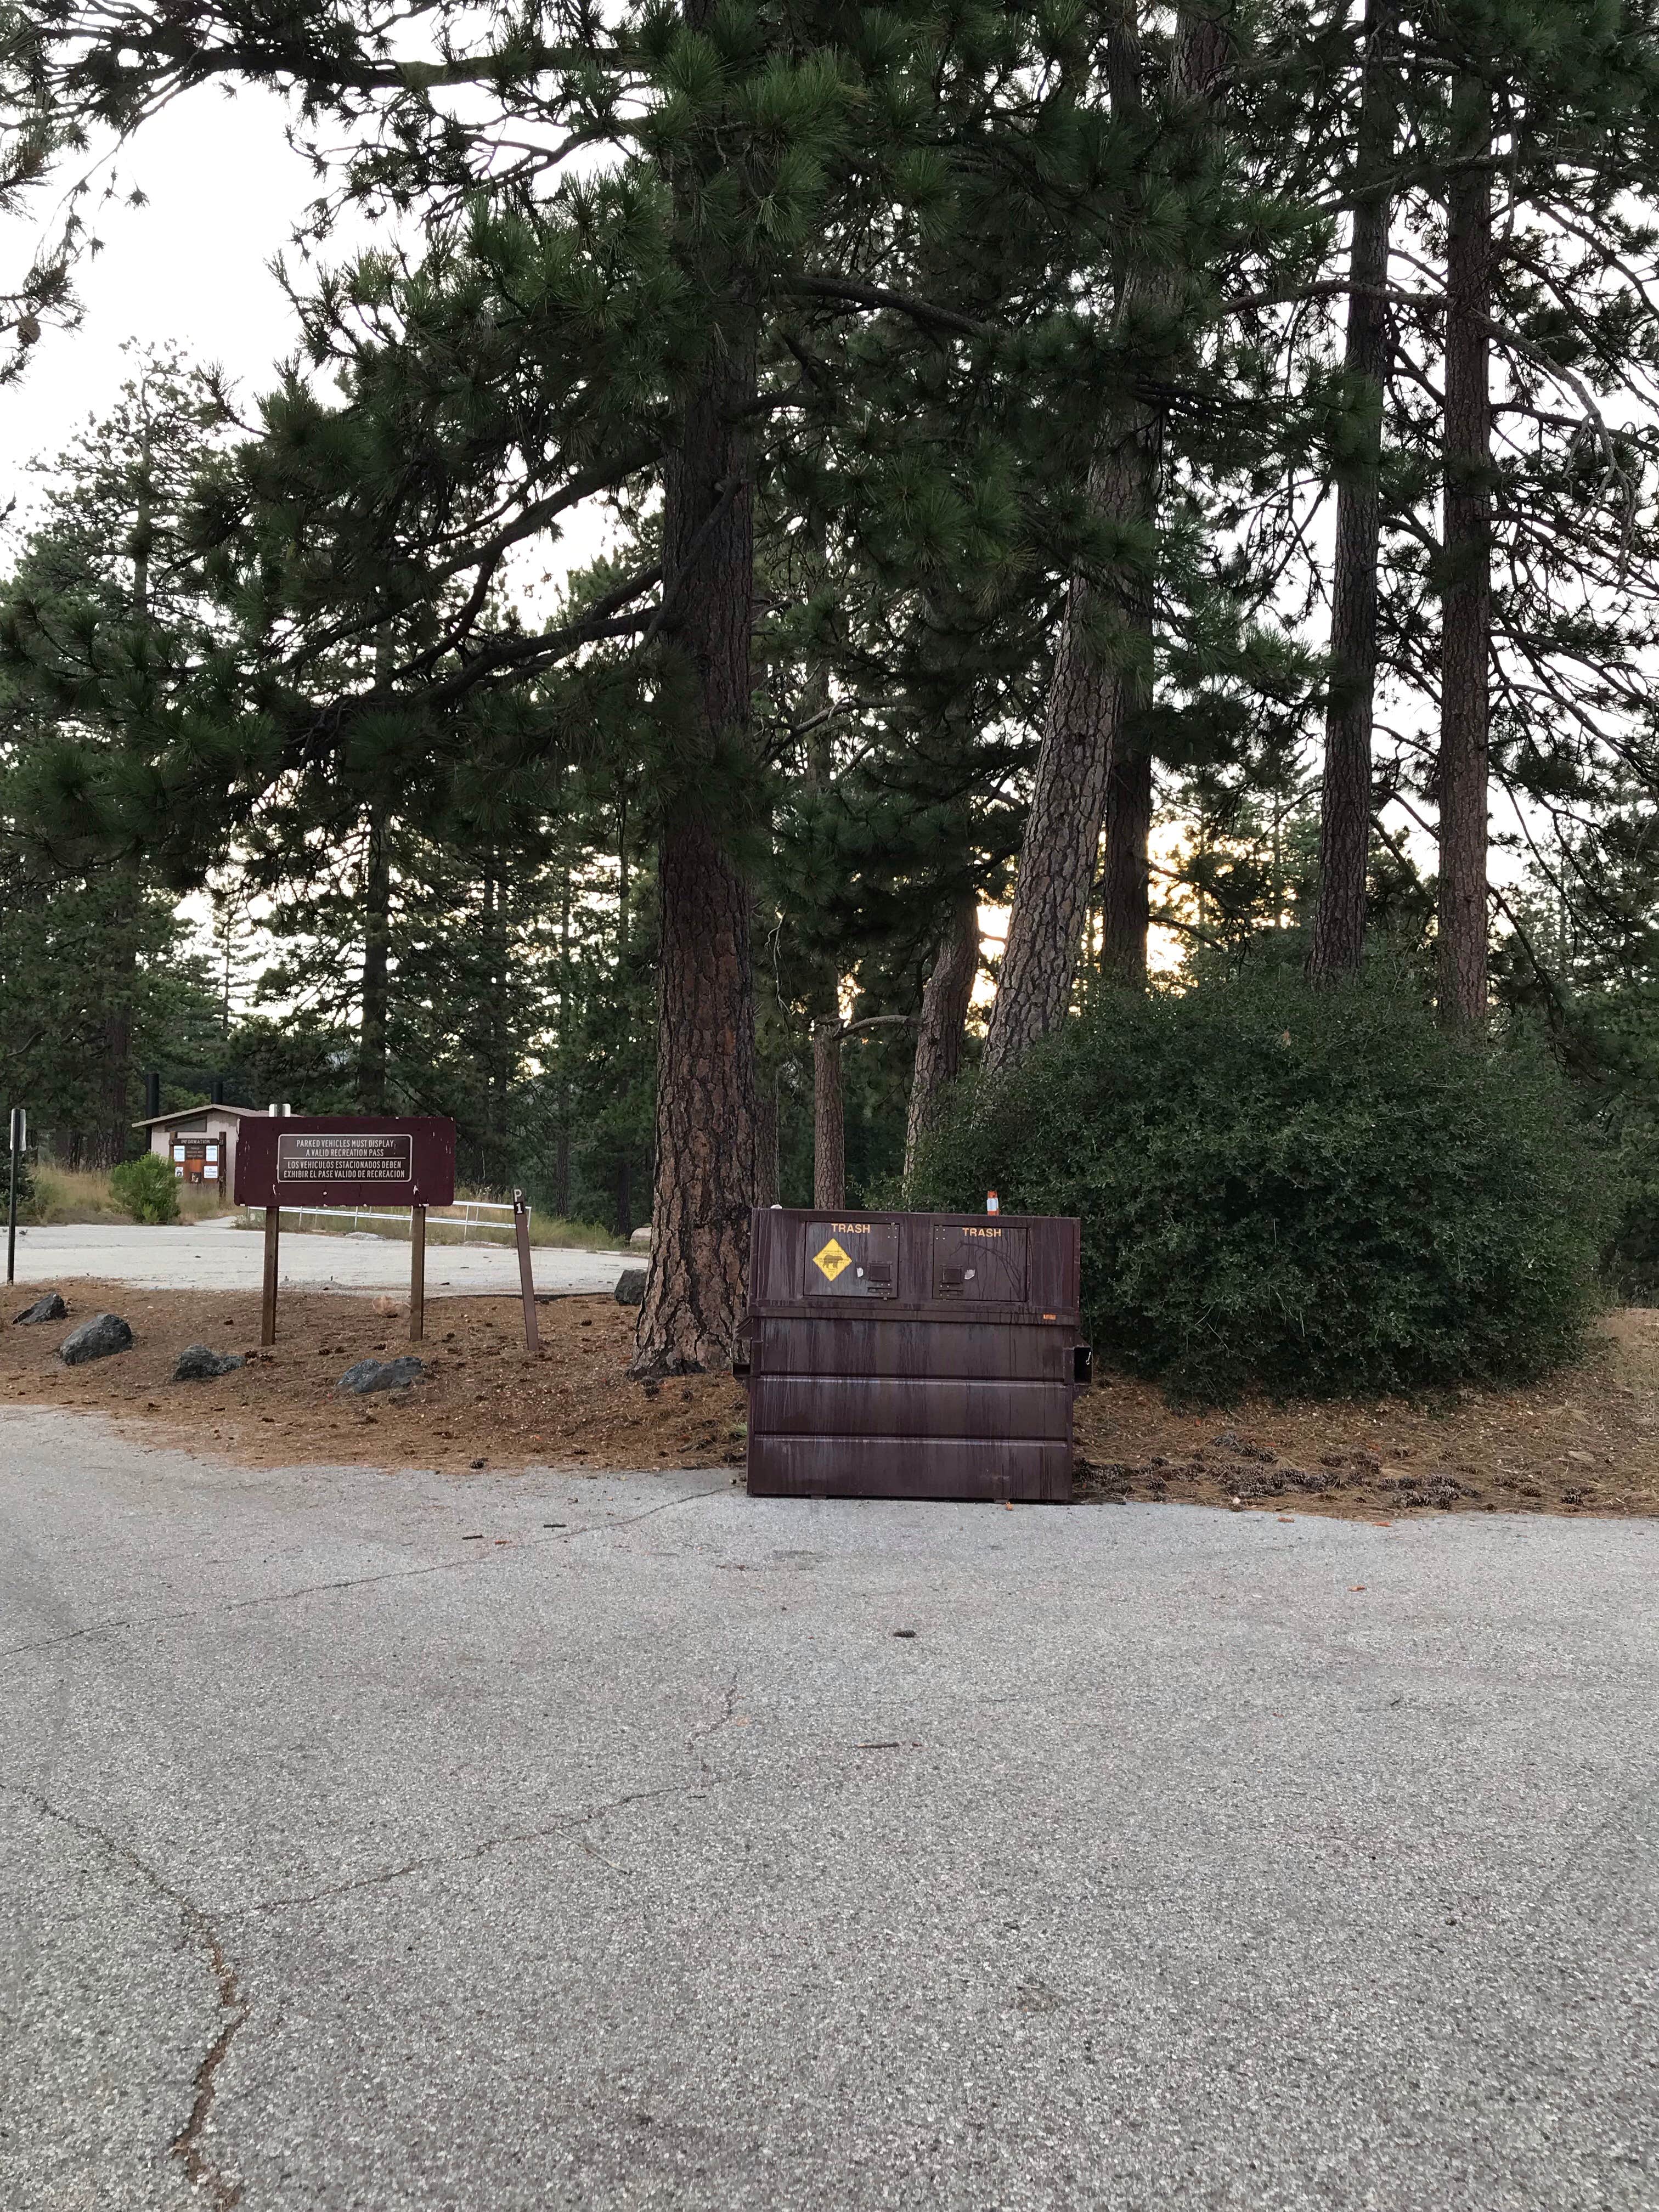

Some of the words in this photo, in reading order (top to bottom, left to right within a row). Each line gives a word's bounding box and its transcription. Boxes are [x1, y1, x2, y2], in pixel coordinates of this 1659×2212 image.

[296, 1139, 320, 1148] PARKED
[321, 1139, 351, 1148] VEHICLES
[351, 1139, 368, 1148] MUST
[368, 1139, 394, 1148] DISPLAY
[287, 1161, 300, 1169] LOS
[300, 1161, 334, 1169] VEHICULOS
[335, 1161, 381, 1169] ESTACIONADOS
[381, 1161, 402, 1169] DEBEN
[514, 1189, 522, 1202] P
[516, 1203, 523, 1214] 1
[831, 1223, 870, 1234] TRASH
[962, 1228, 1001, 1238] TRASH
